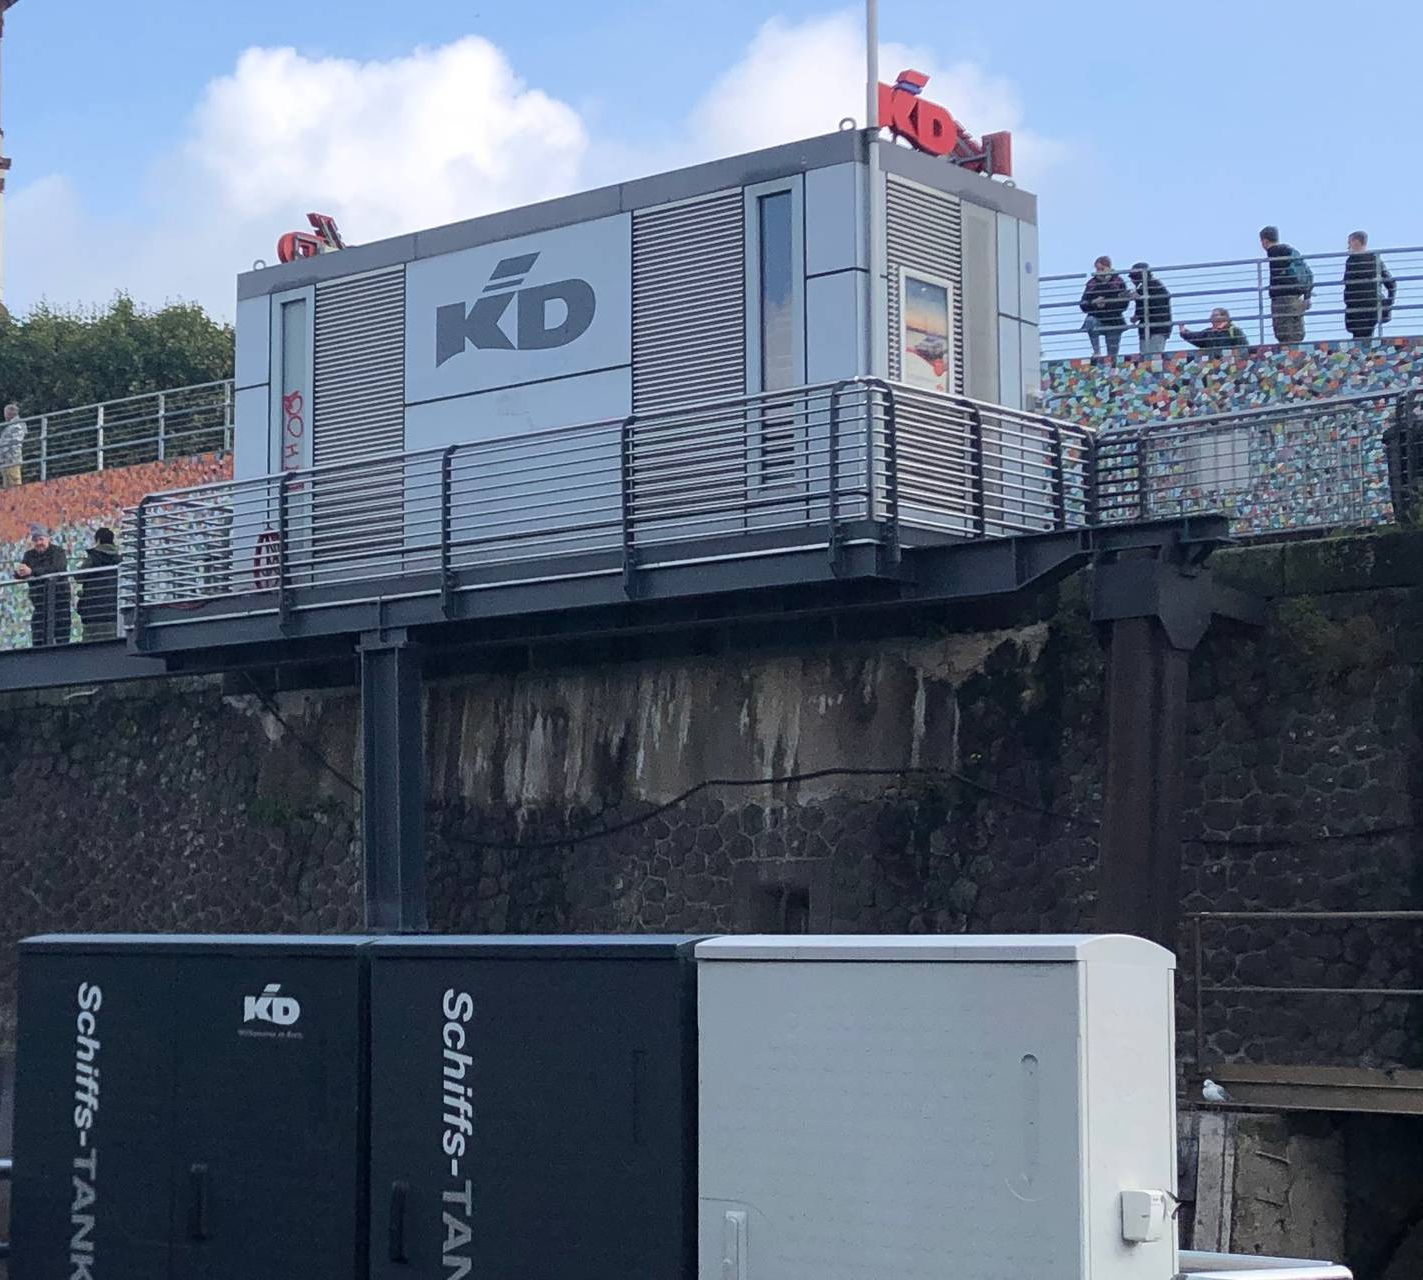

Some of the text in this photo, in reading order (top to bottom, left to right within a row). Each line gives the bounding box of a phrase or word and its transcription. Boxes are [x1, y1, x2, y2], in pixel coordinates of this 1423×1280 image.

[878, 69, 958, 157] KD
[436, 252, 596, 368] KD
[244, 984, 300, 1025] KD
[70, 982, 102, 1280] Schiffs-TANK
